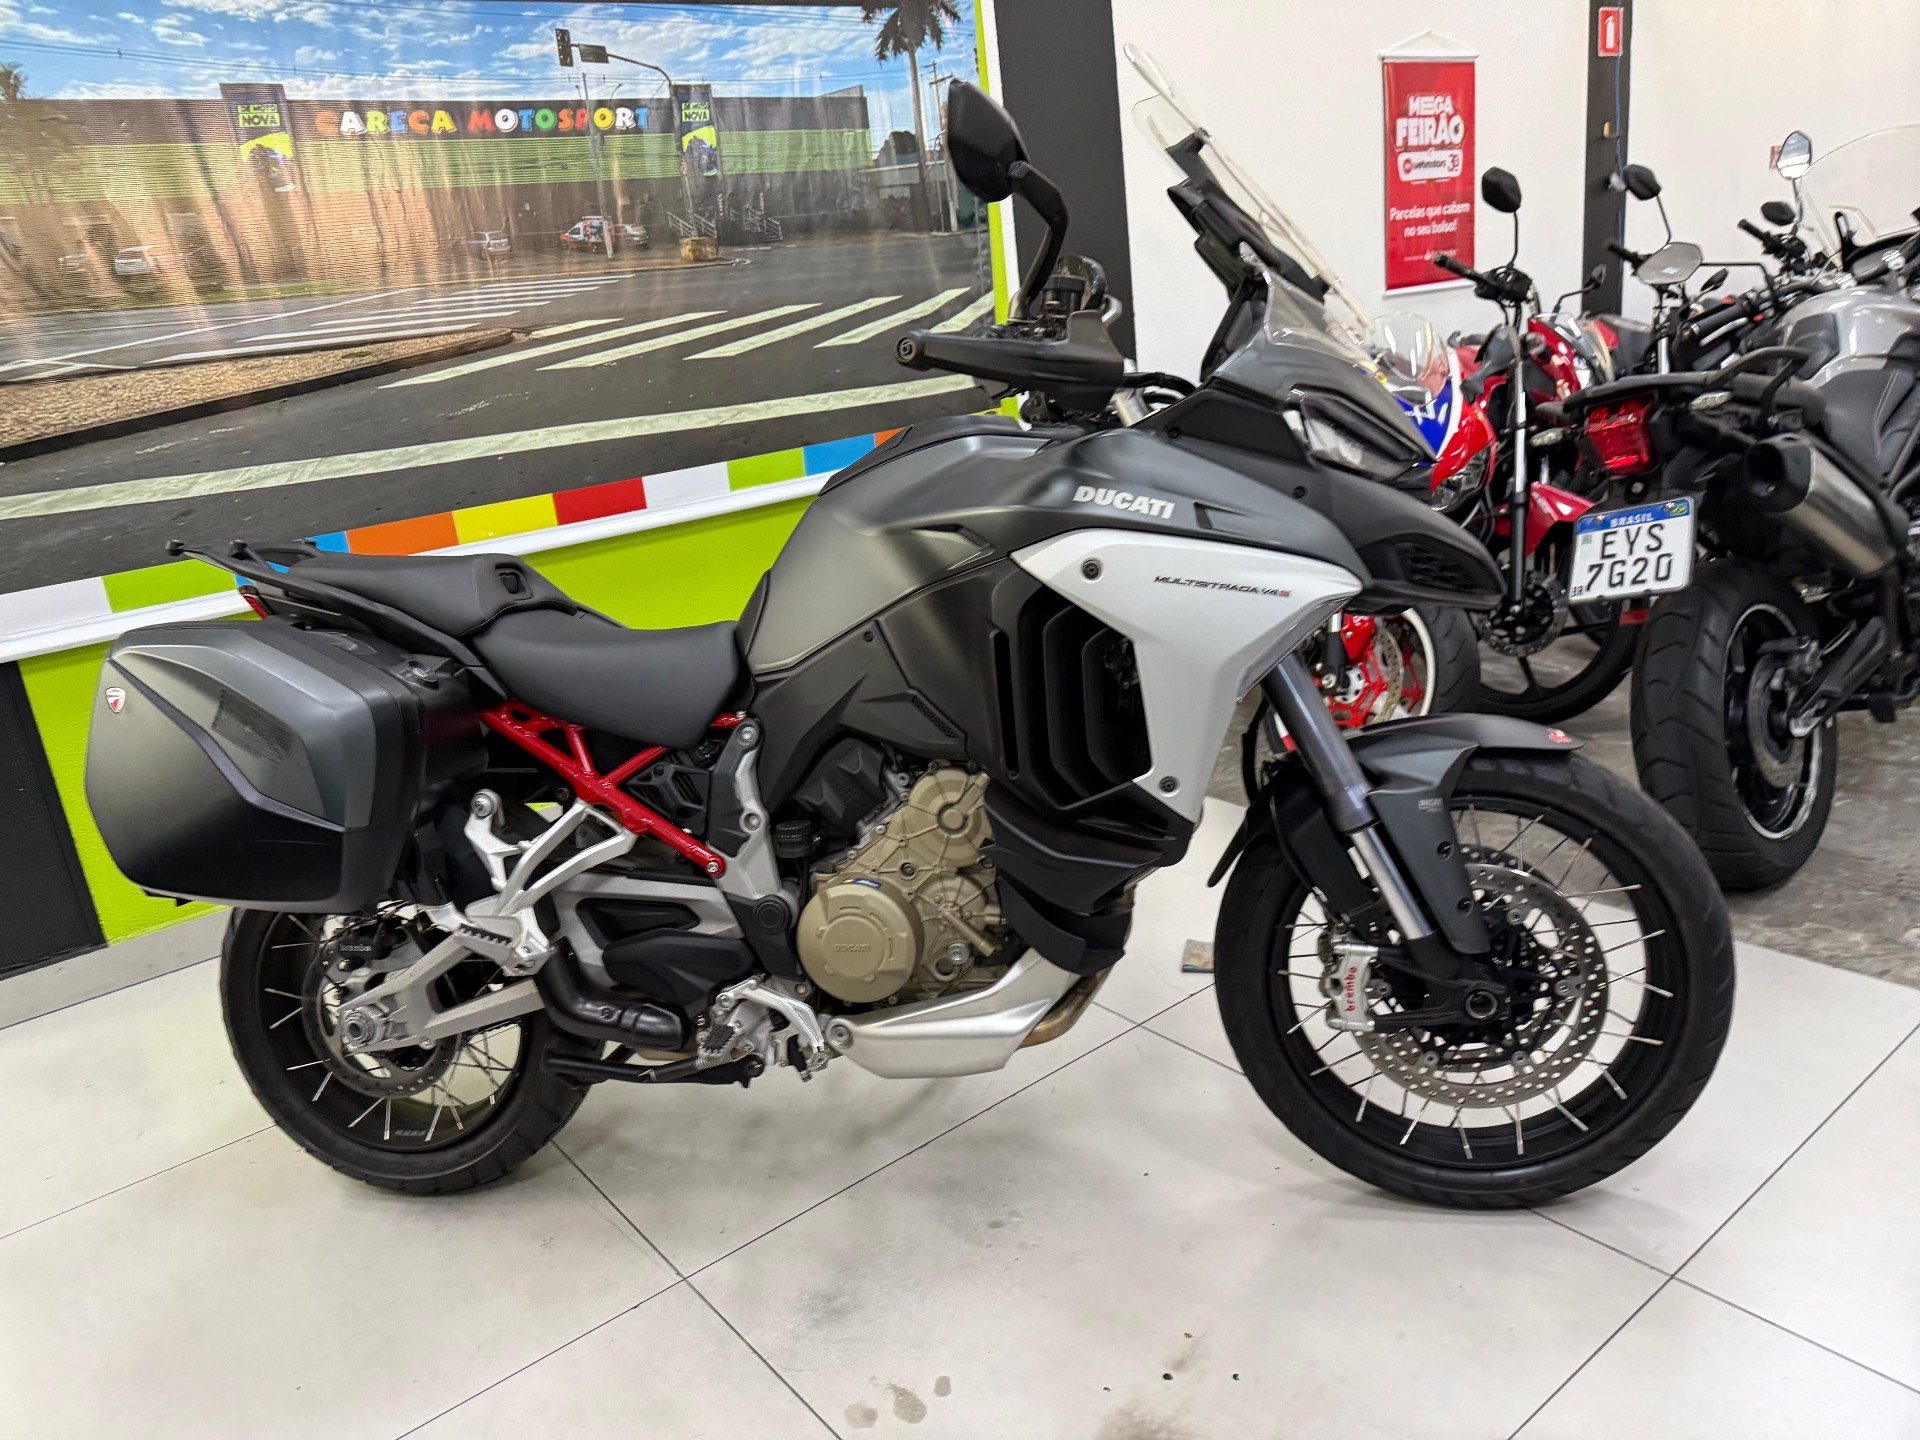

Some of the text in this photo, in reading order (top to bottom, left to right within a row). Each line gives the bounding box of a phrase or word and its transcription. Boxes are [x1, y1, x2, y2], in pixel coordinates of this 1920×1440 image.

[684, 111, 708, 121] NOVA
[1408, 95, 1454, 116] MEGA
[242, 114, 278, 126] NOVA
[315, 107, 650, 135] CARECA MOTOSPORT
[1396, 112, 1464, 147] FEIRÃO
[1390, 201, 1470, 221] Parcelas que cabem
[1404, 226, 1416, 237] no
[1416, 225, 1431, 236] seu
[1072, 485, 1176, 519] DUCATI
[1610, 512, 1655, 528] BRASIL
[1600, 523, 1664, 560] EYS
[1586, 552, 1674, 592] 7G20
[833, 943, 872, 953] DUCATI
[1344, 966, 1358, 1012] brembo
